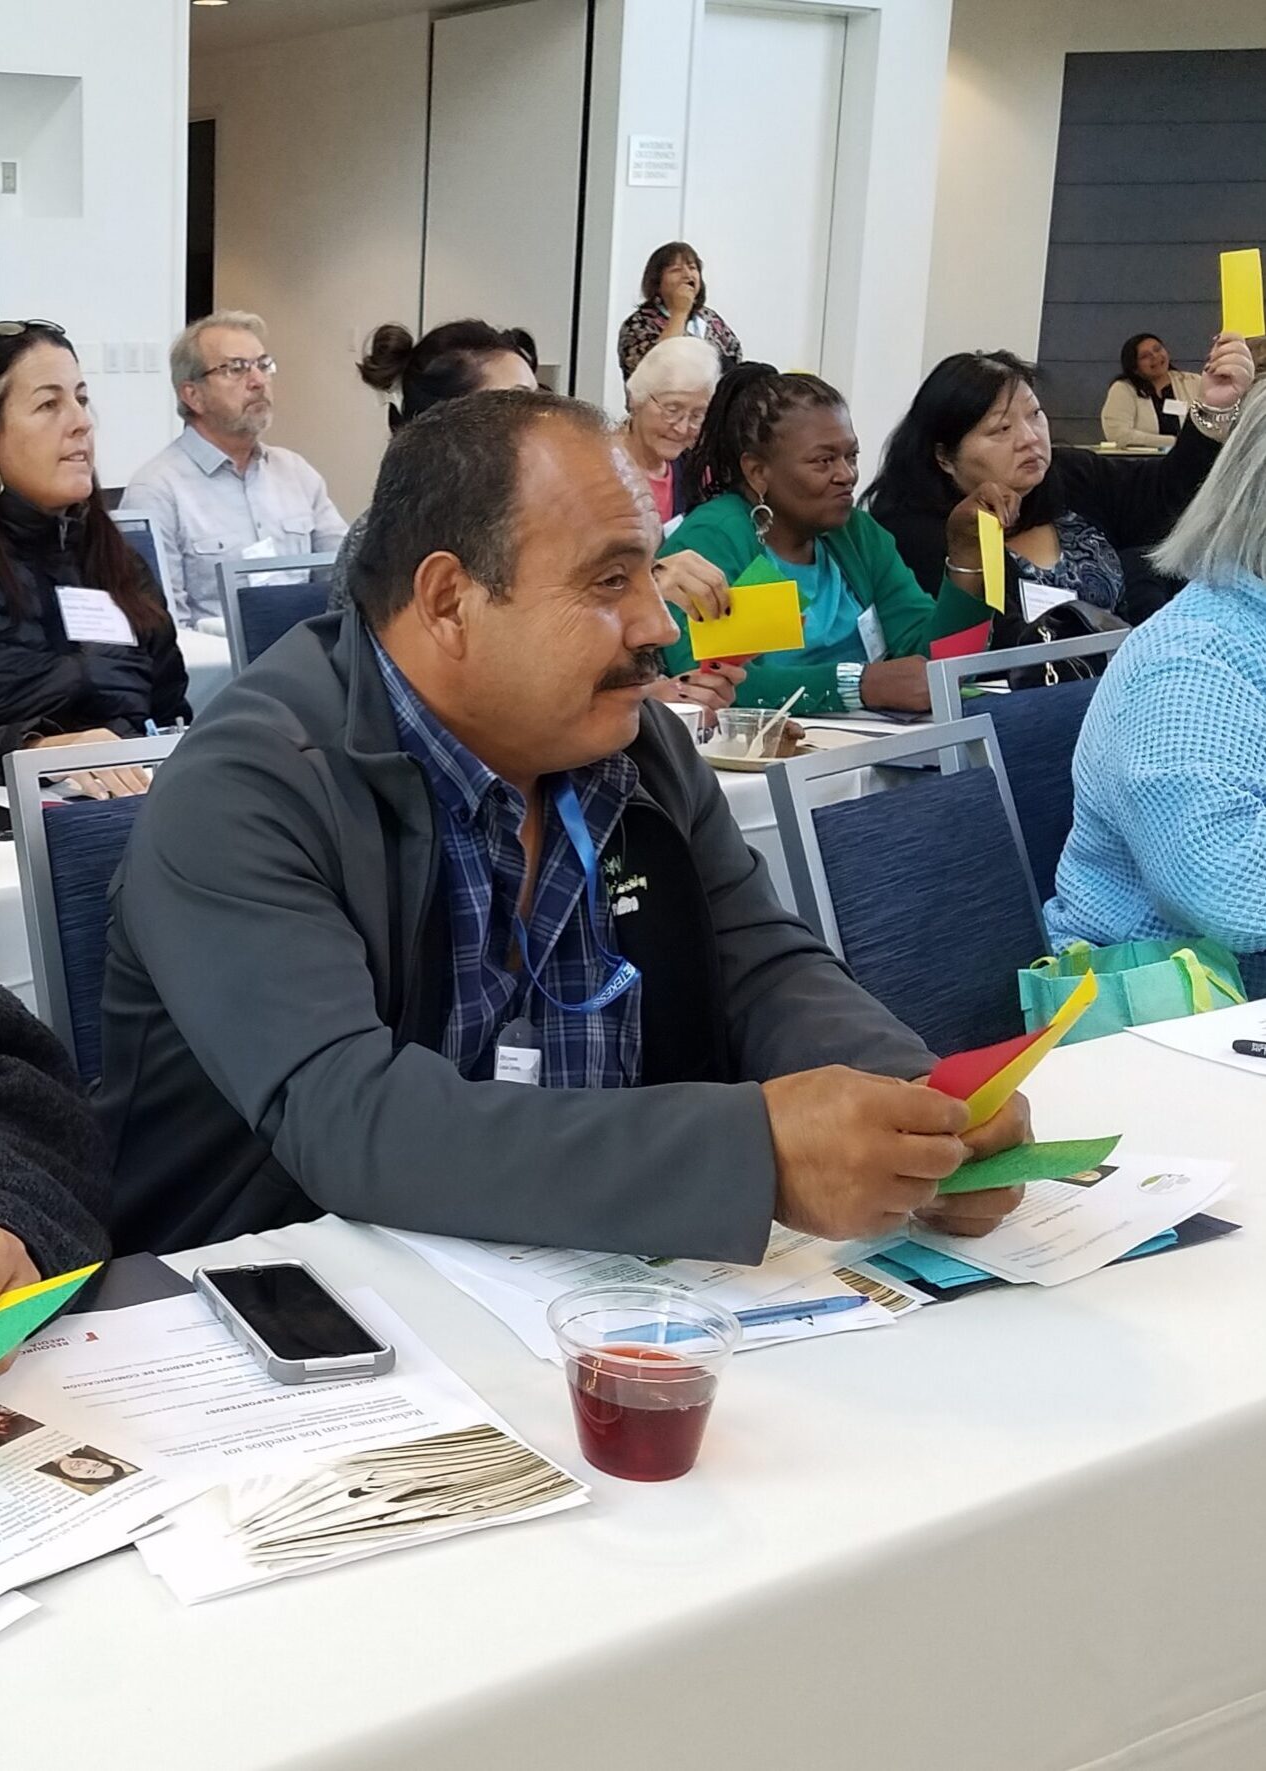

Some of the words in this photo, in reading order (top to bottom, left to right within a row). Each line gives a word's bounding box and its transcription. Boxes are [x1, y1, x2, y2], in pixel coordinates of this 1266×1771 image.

[17, 1341, 69, 1355] RESOURC
[275, 1392, 296, 1400] LOS
[349, 1408, 424, 1429] Relaciones
[299, 1429, 321, 1442] los
[322, 1423, 348, 1435] con
[245, 1433, 297, 1453] medios
[221, 1447, 243, 1457] 101
